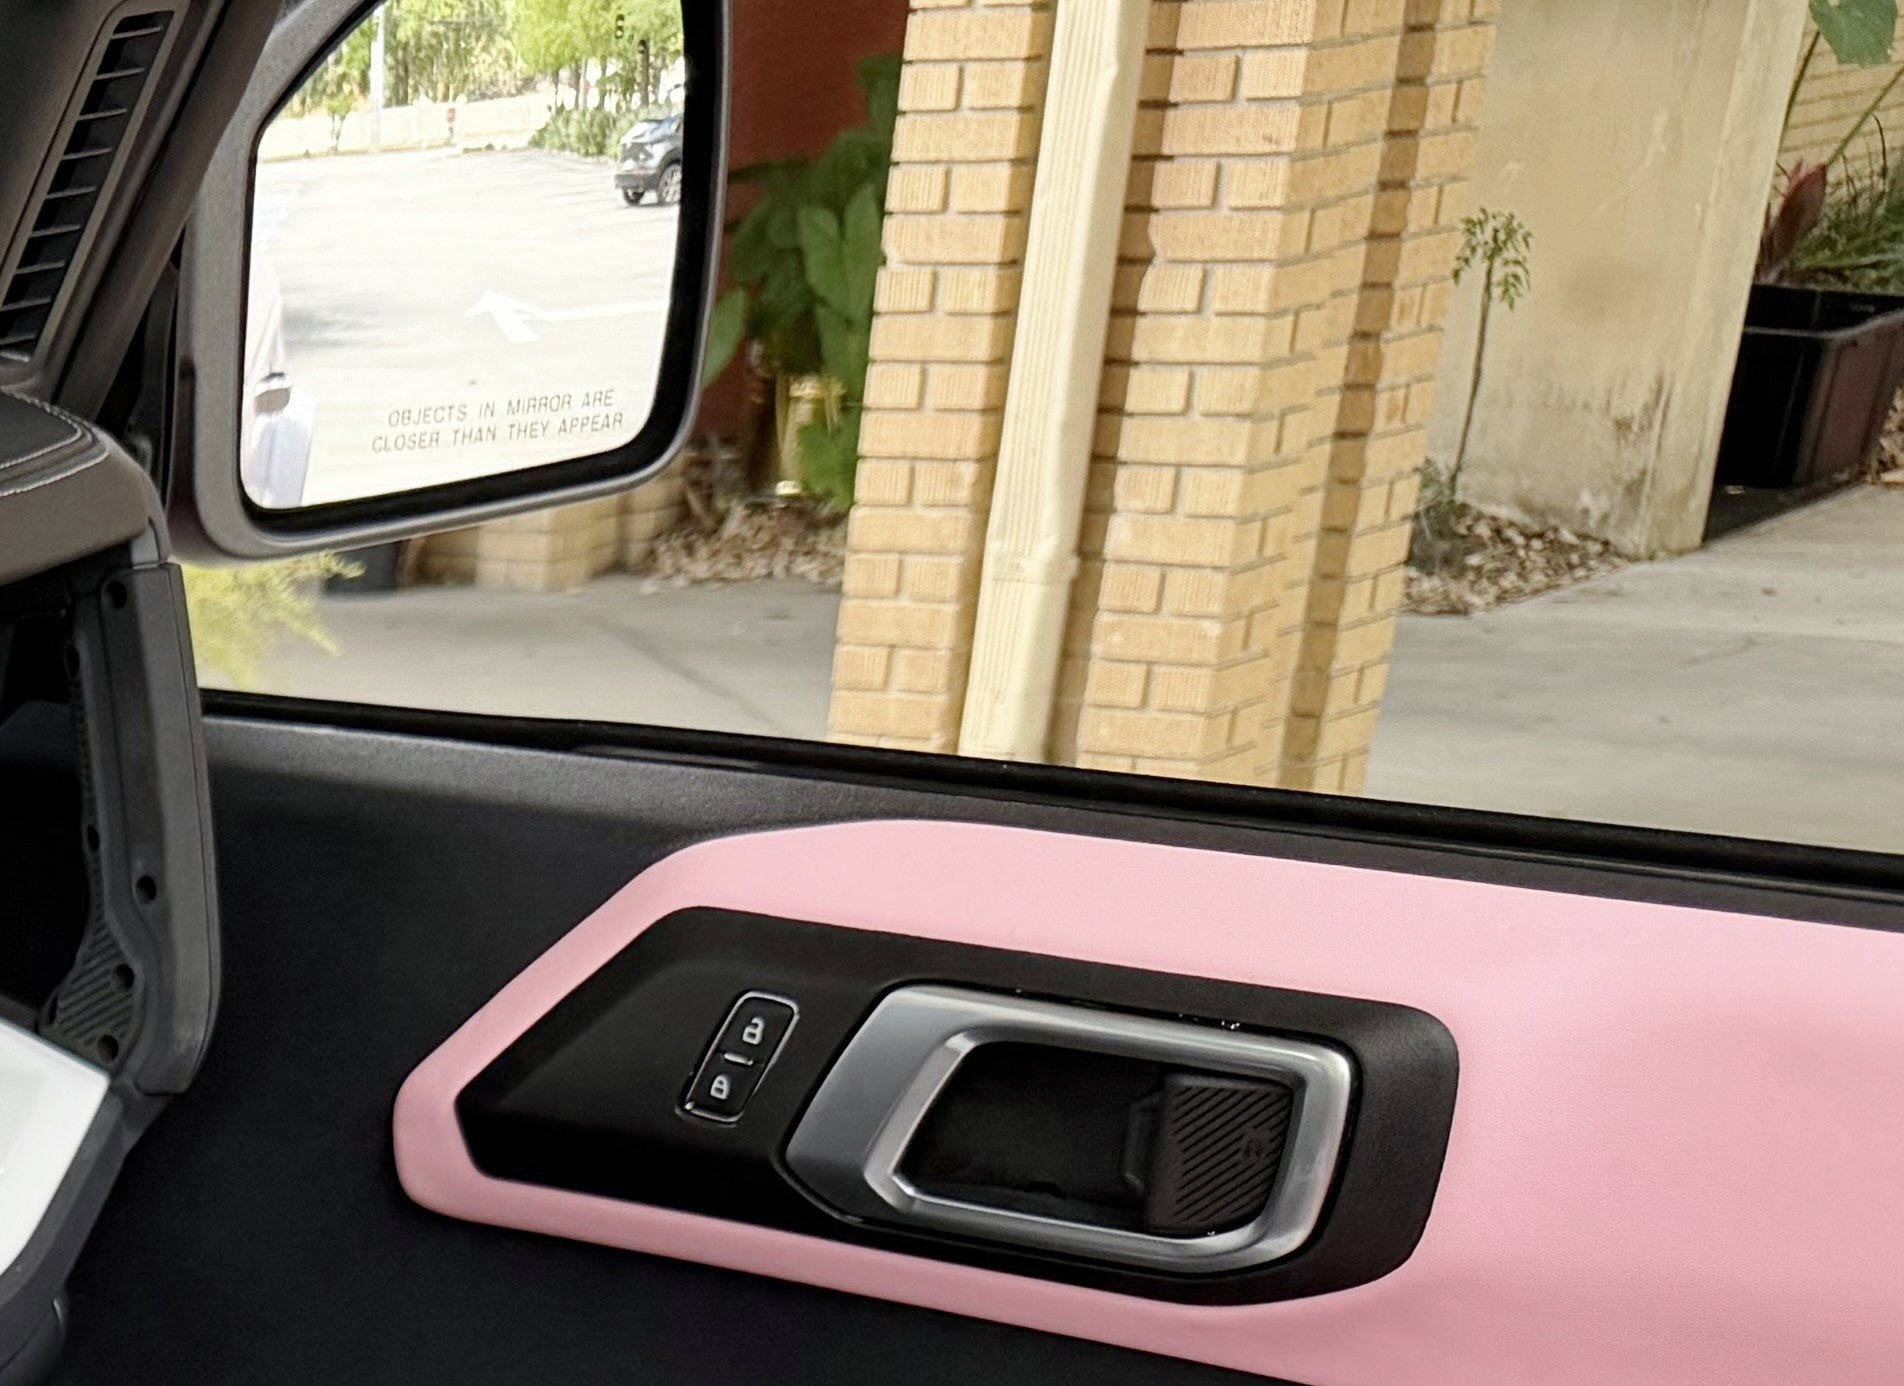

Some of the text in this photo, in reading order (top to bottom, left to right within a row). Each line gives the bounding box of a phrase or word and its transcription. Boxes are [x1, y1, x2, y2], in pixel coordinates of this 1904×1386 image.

[388, 389, 615, 428] OBJECTS IN MIRROR ARE
[372, 412, 624, 453] CLOSER THAN THEY APPEAR
